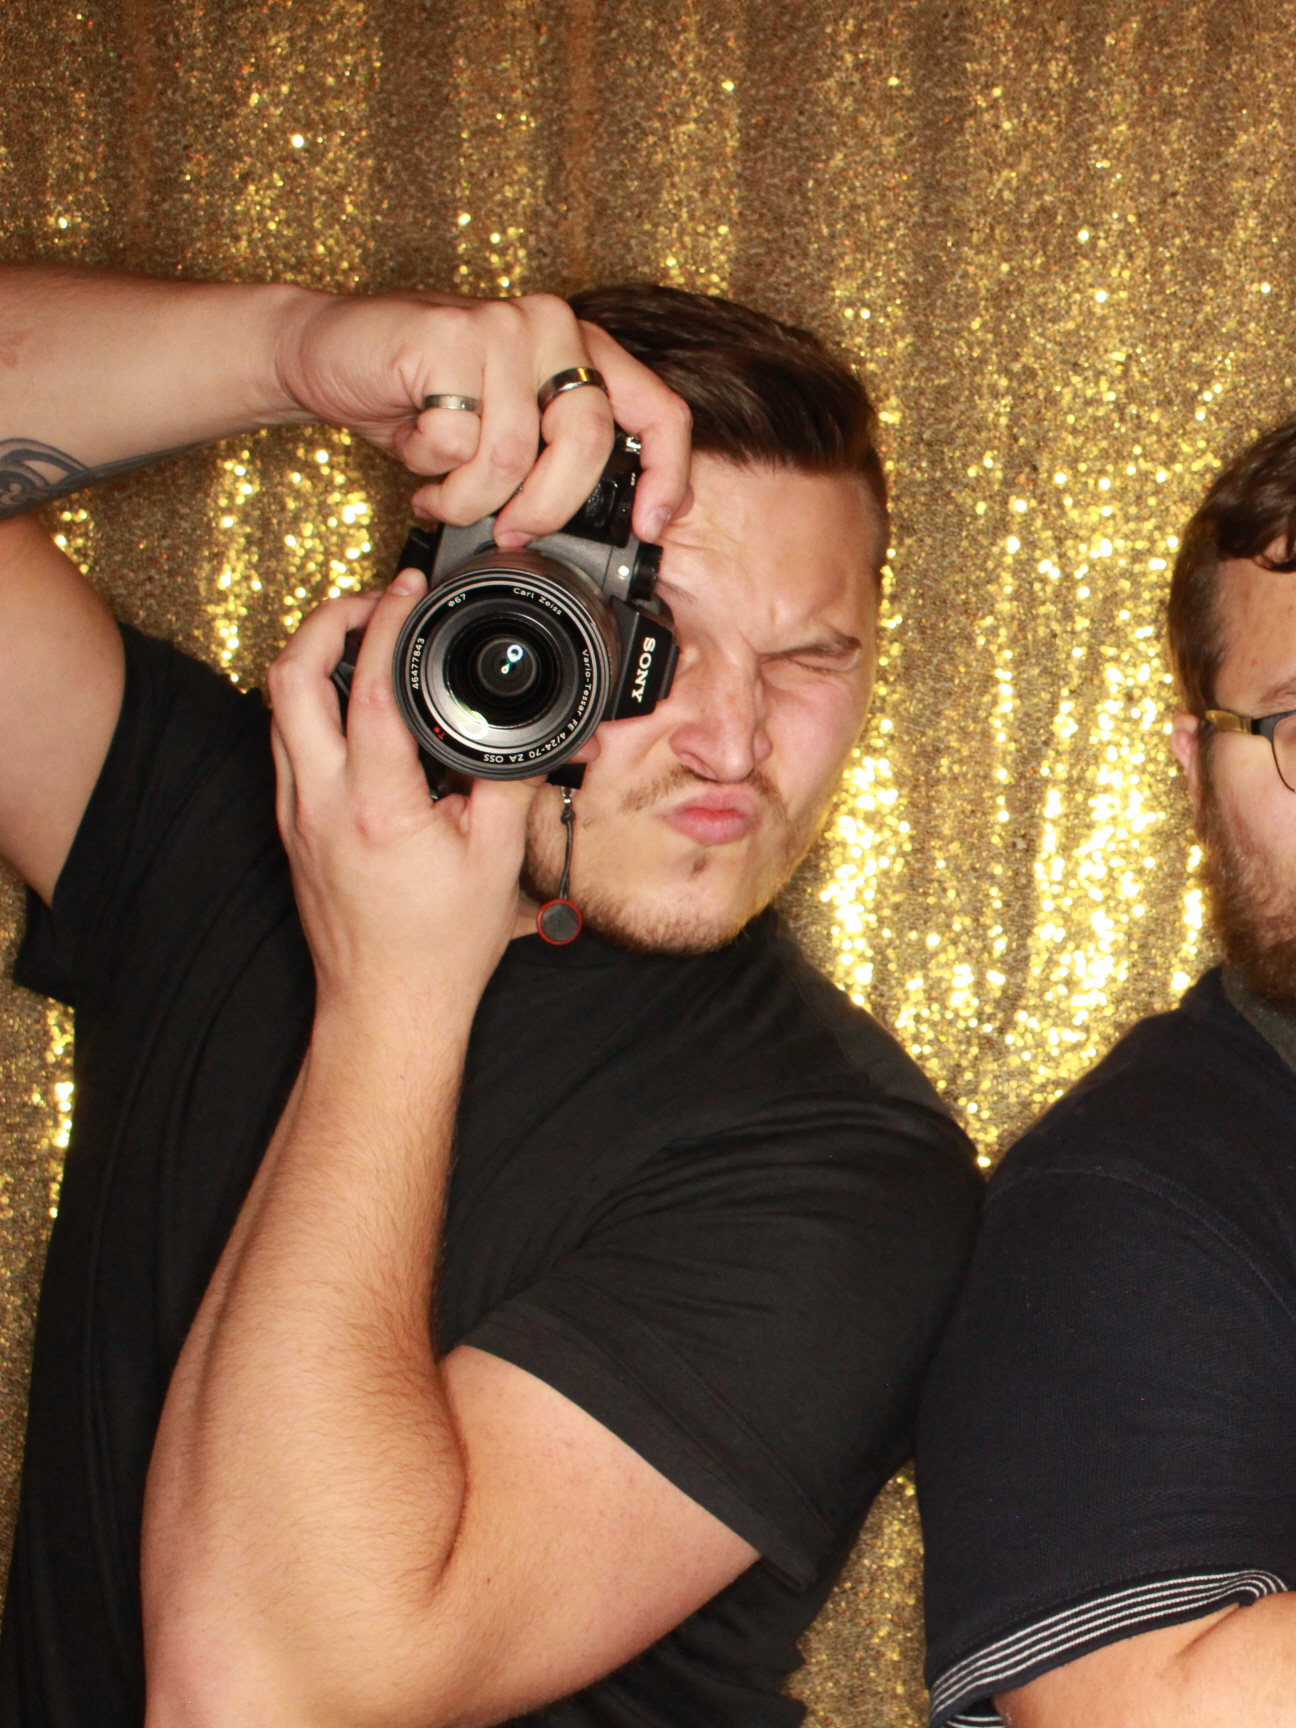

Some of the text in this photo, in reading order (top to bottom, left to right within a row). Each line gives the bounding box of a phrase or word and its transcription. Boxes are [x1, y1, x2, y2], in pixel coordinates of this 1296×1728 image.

[513, 587, 563, 616] Carl Zeiss
[411, 637, 425, 690] 46477843
[631, 636, 657, 703] SONY
[483, 649, 593, 763] Vario-Tessar FE 4/24-70 ZA OSS
